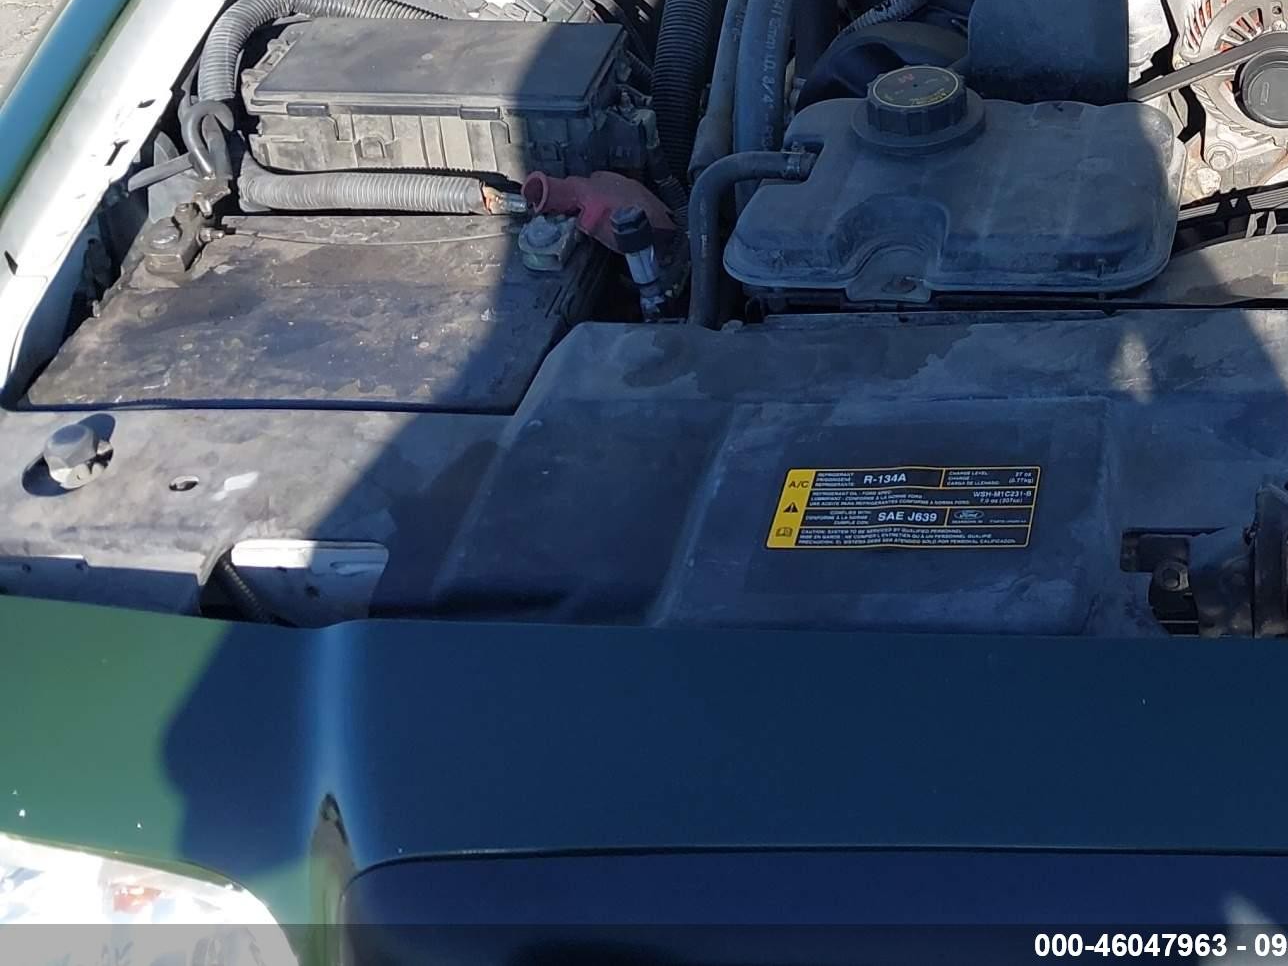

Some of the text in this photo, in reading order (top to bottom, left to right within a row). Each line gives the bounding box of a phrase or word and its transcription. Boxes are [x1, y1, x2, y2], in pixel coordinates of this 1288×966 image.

[788, 480, 809, 488] A/C
[863, 473, 907, 485] R-134A
[878, 512, 904, 522] SAE
[908, 512, 938, 522] J639
